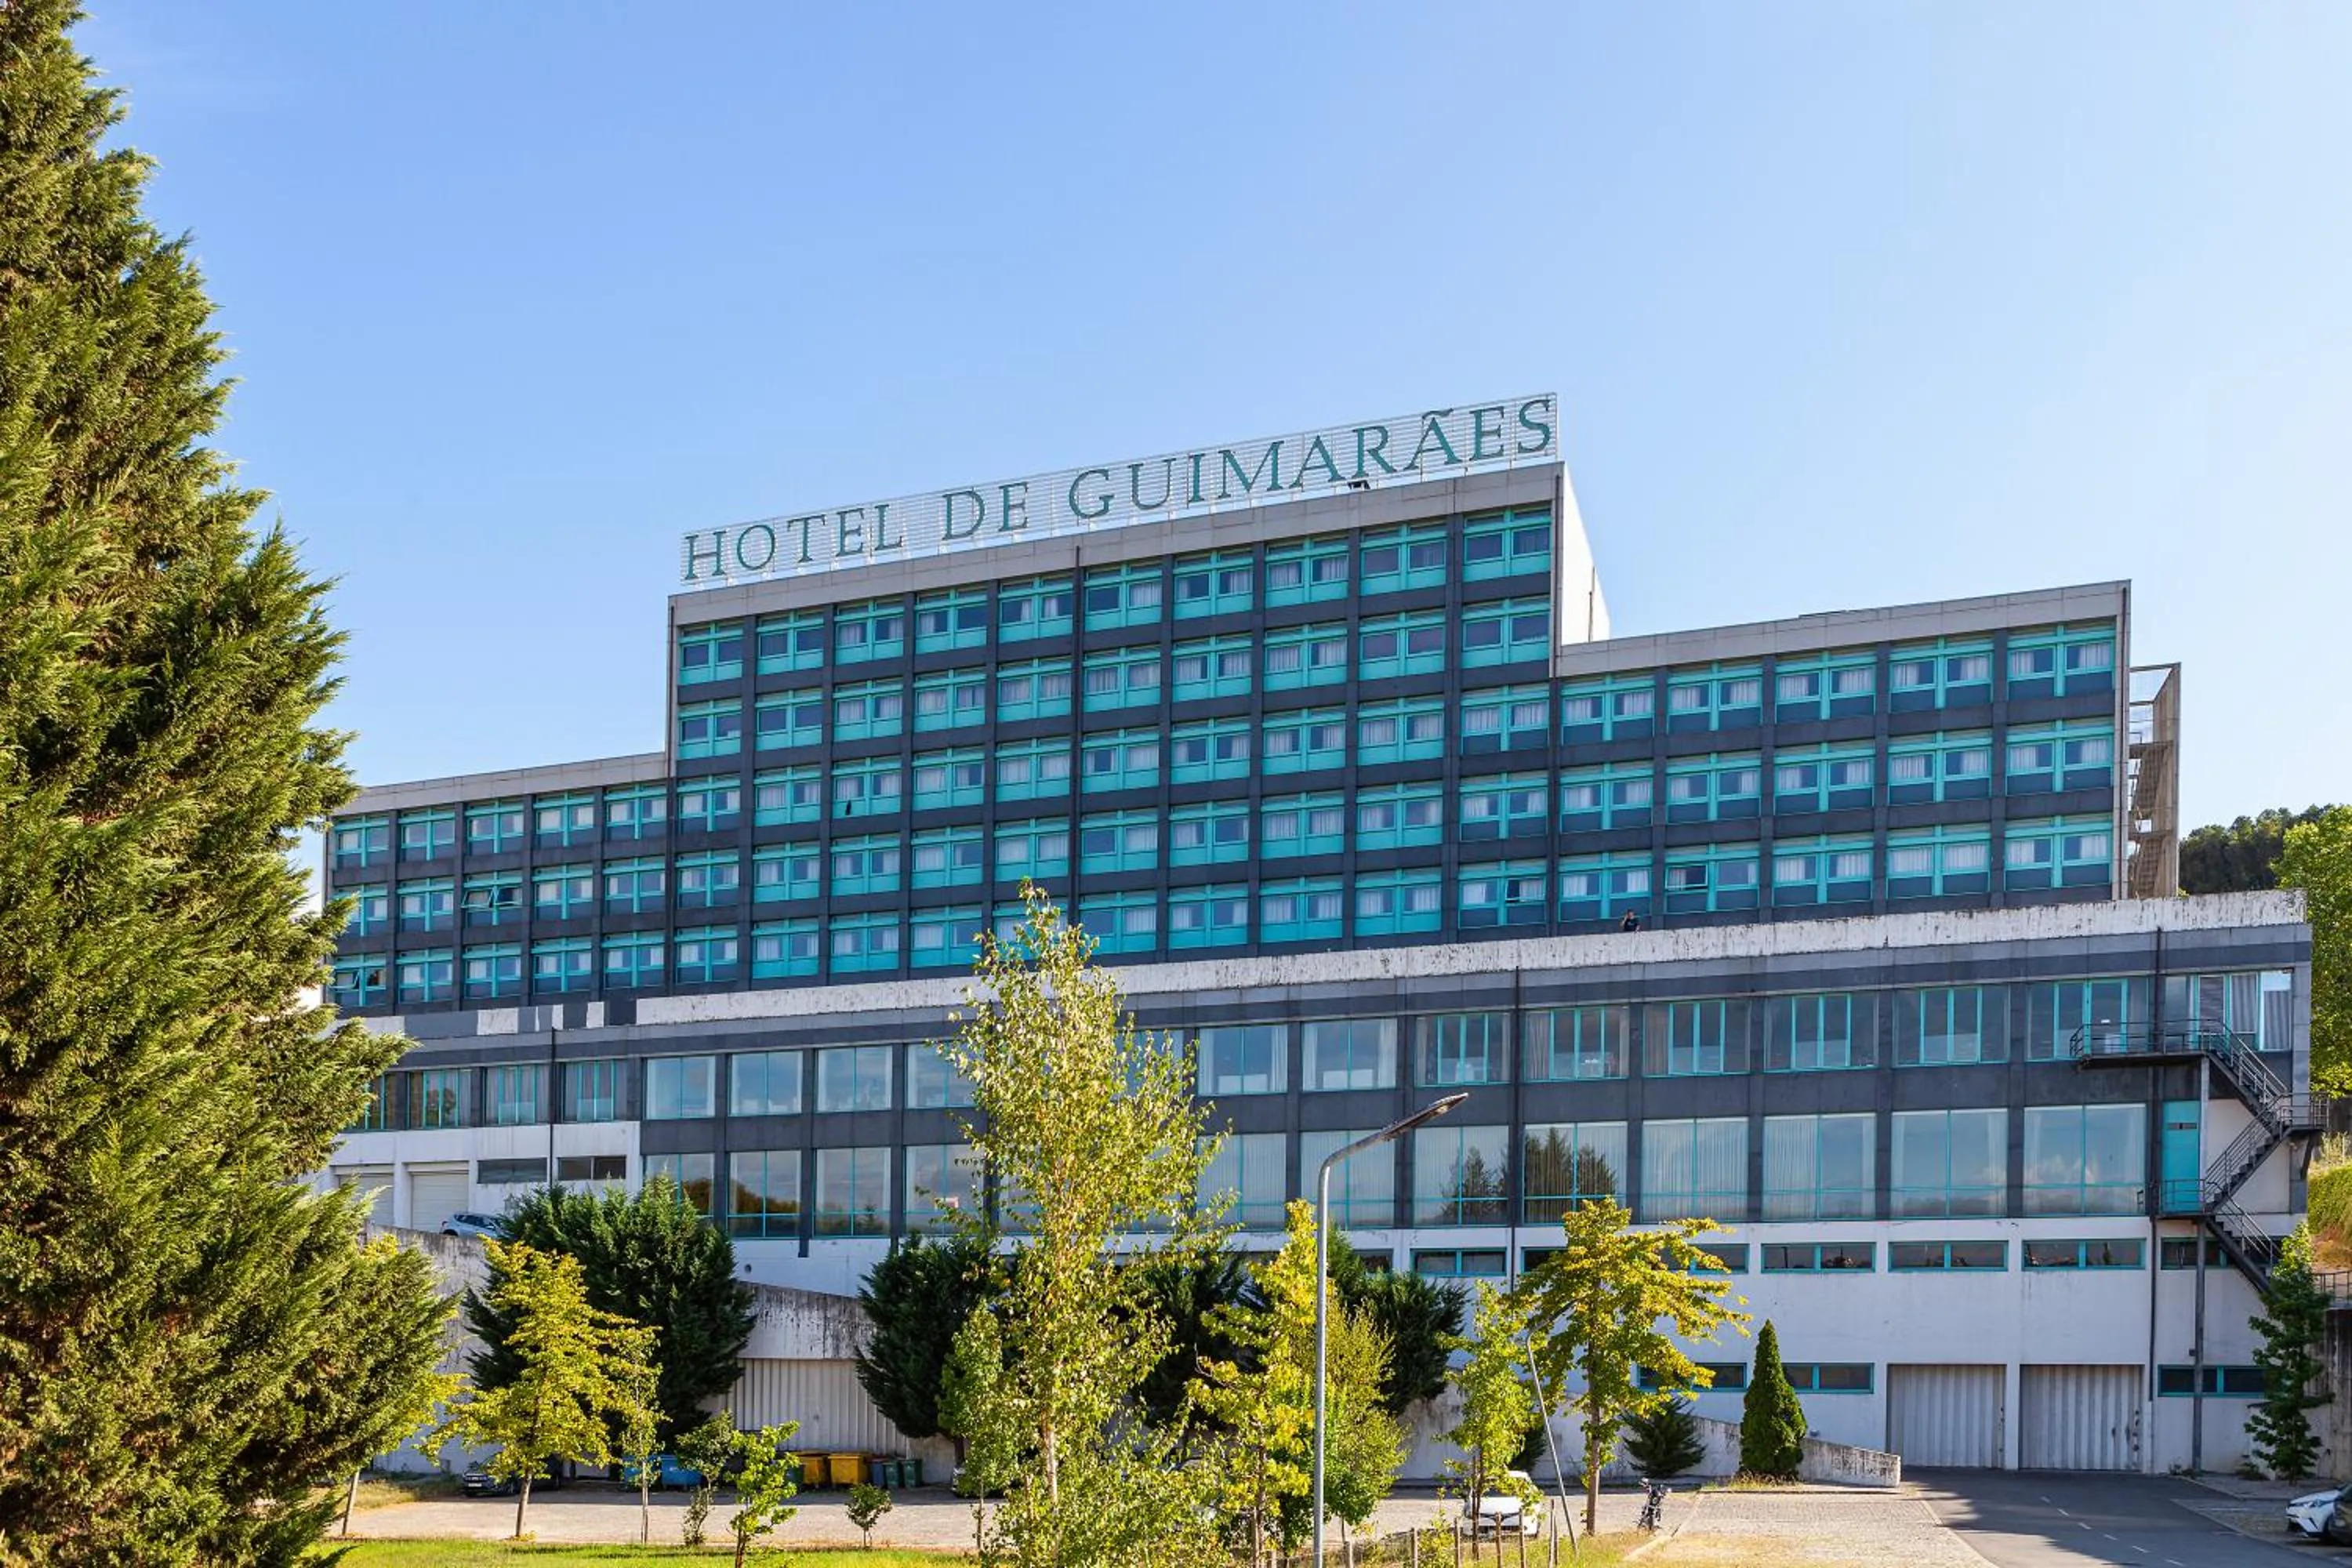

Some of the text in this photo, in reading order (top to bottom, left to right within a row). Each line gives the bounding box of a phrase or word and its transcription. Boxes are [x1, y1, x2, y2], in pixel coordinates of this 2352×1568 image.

[684, 399, 1552, 580] HOTEL DE GUIMARÃES
